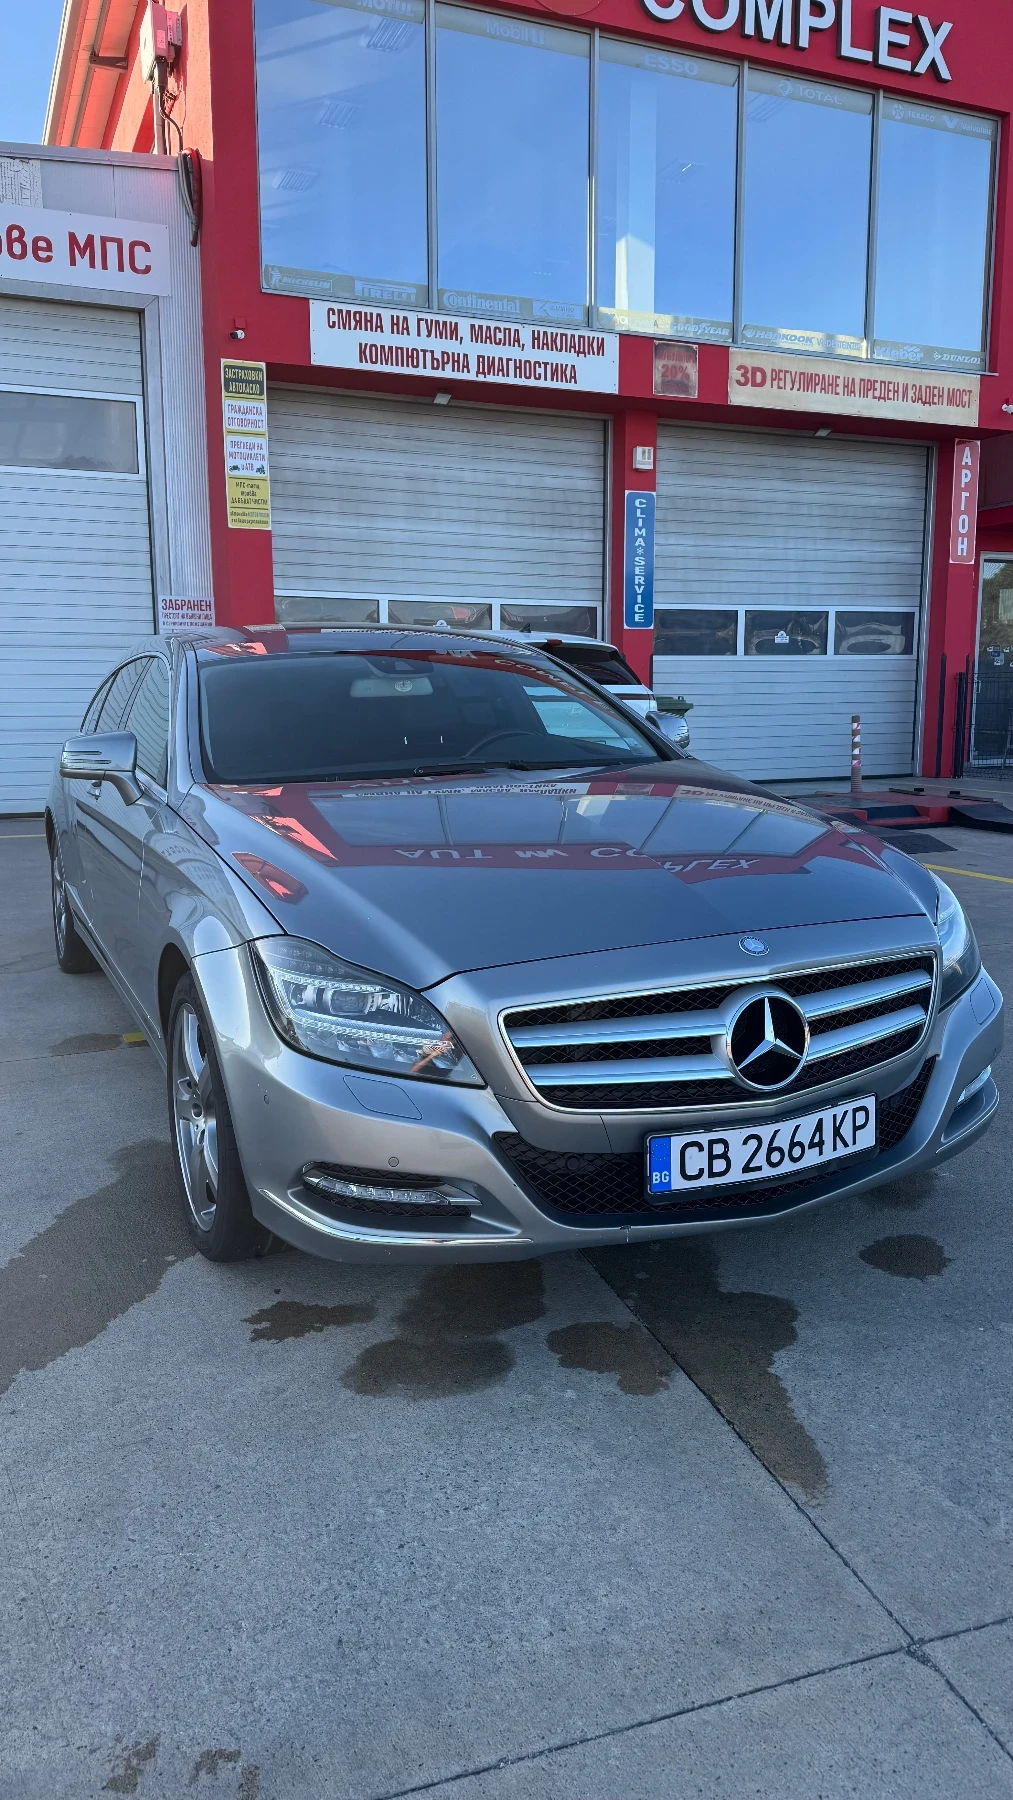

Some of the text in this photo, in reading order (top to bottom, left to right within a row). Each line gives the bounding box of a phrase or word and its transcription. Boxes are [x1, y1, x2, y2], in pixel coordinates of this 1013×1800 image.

[644, 53, 699, 76] ESSO
[796, 83, 843, 106] TOTAL
[907, 110, 935, 123] TEXACO
[961, 122, 993, 136] Valvoline
[0, 223, 152, 275] ве МПС
[281, 277, 331, 290] MICHELIN
[354, 279, 417, 303] PIRELLI
[443, 291, 521, 314] Continental
[327, 307, 605, 358] СМЯНА НА ГУМИ, МАСЛА, НАКЛАДКИ
[358, 342, 578, 384] КОМПЮТЪРНА ДИАГНОСТИКА
[875, 345, 924, 361] Kleber
[225, 367, 263, 381] ЗАСТРАХОВКИ
[661, 363, 691, 383] 20%
[228, 382, 260, 394] АВТОКАСКО
[735, 364, 973, 408] 3D РЕГУЛИРАНЕ НА ПРЕДЕН И ЗАДЕН МОСТ
[227, 404, 263, 416] ГРАЖДАНСКА
[227, 417, 264, 429] ОТГОВОРНОСТ
[957, 446, 972, 556] АРГОН
[634, 498, 647, 622] CLIMA SERVICE
[161, 598, 212, 612] ЗАБРАНЕН
[679, 1104, 871, 1181] CB 2664 KP
[652, 1171, 670, 1185] BG
